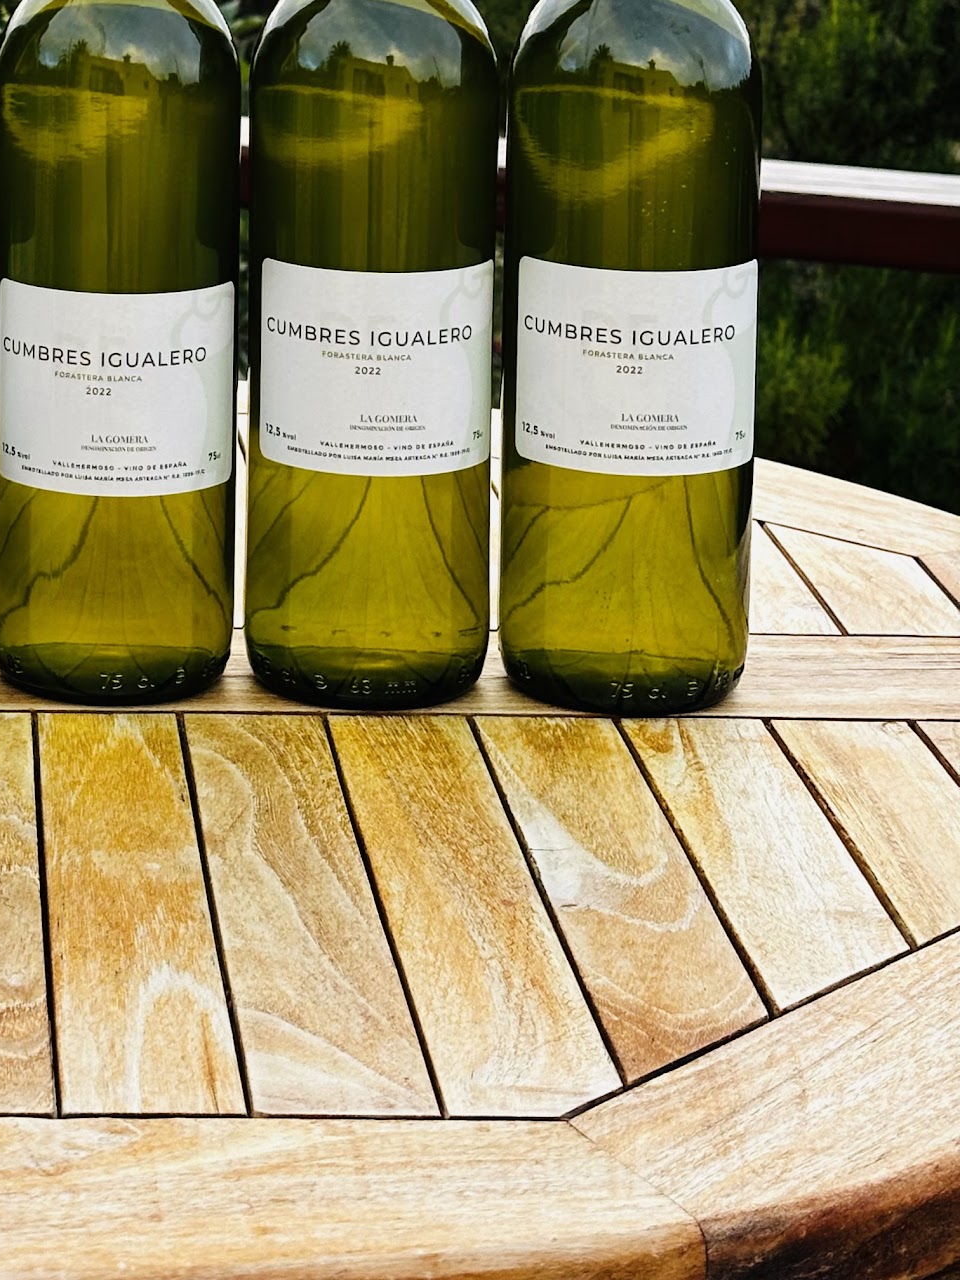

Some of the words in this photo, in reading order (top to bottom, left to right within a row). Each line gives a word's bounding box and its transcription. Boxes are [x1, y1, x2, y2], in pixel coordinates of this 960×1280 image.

[267, 317, 361, 345] CUMBRES
[370, 325, 472, 347] IGUALERO
[524, 315, 622, 344] CUMBRES
[632, 324, 736, 346] IGUALERO
[3, 336, 91, 366] CUMBRES
[101, 347, 206, 368] IGUALERO
[321, 351, 373, 361] FORASTERA
[582, 349, 634, 360] FORASTERA
[638, 353, 674, 361] BLANCA
[355, 366, 381, 375] 2022
[616, 365, 643, 375] 2022
[54, 371, 104, 381] FORASTERA
[85, 387, 112, 396] 2022
[360, 414, 373, 423] LA
[375, 414, 418, 423] GOMERA
[621, 413, 635, 422] LA
[637, 414, 679, 423] GOMERA
[91, 434, 103, 443] LA
[105, 435, 148, 444] GOMERA
[320, 440, 384, 451] VALLEHERMOSO
[428, 440, 454, 449] ESPAÑA
[580, 440, 645, 450] VALLEHERMOSO
[690, 440, 716, 449] ESPAÑA
[52, 460, 114, 471] VALLEHERMOSO
[160, 461, 187, 469] ESPAÑA
